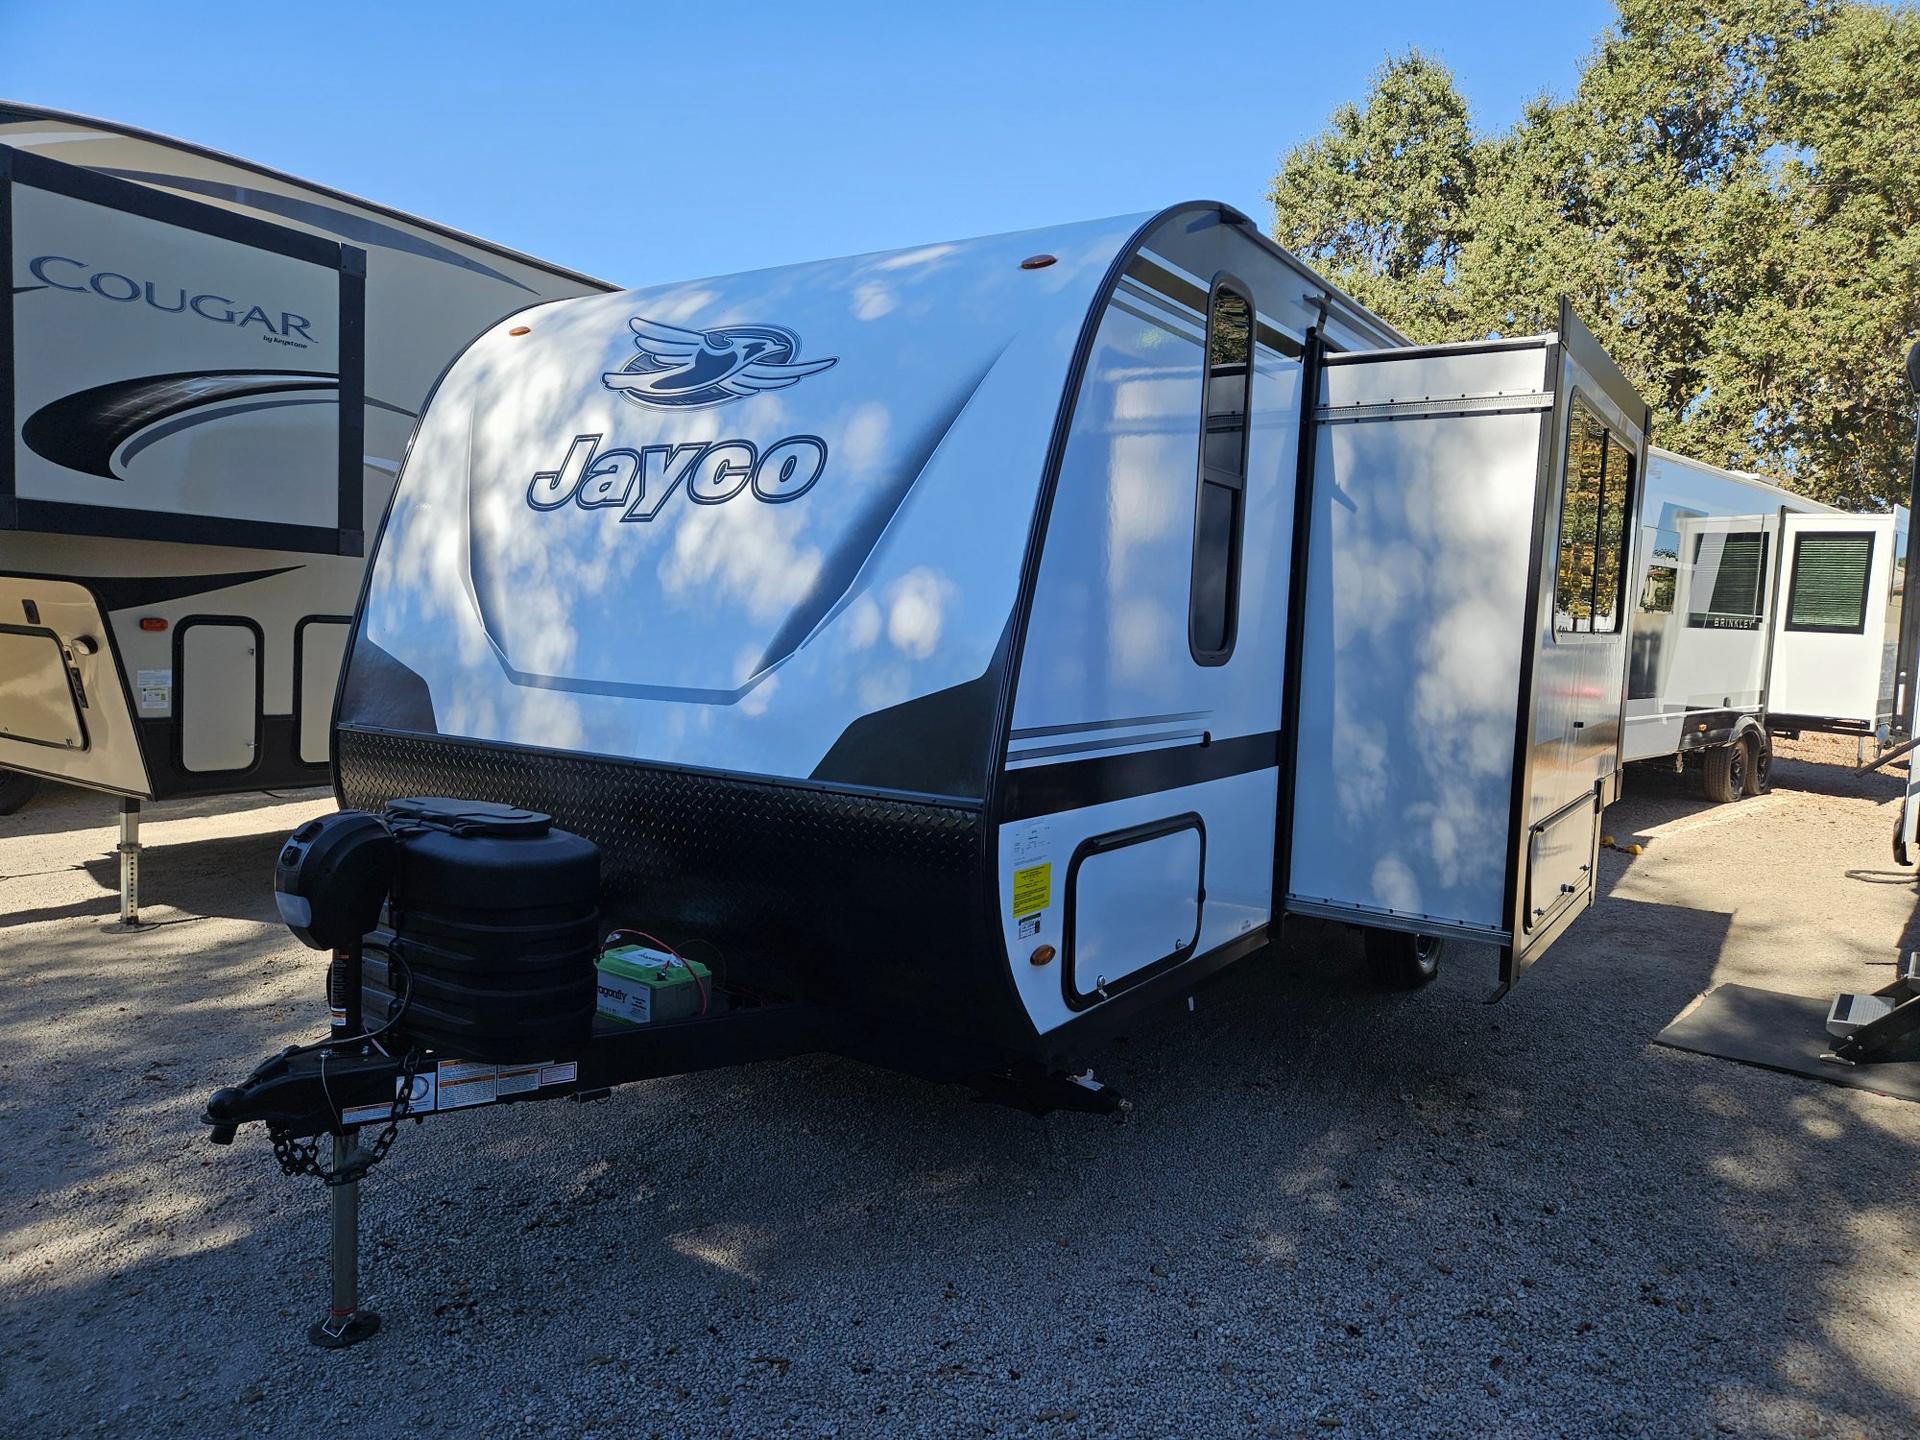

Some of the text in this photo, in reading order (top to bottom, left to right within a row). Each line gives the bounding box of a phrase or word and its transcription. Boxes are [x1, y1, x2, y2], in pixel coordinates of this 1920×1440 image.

[263, 334, 273, 344] by
[526, 433, 829, 523] Jayco
[1713, 617, 1755, 629] BRINKLEY
